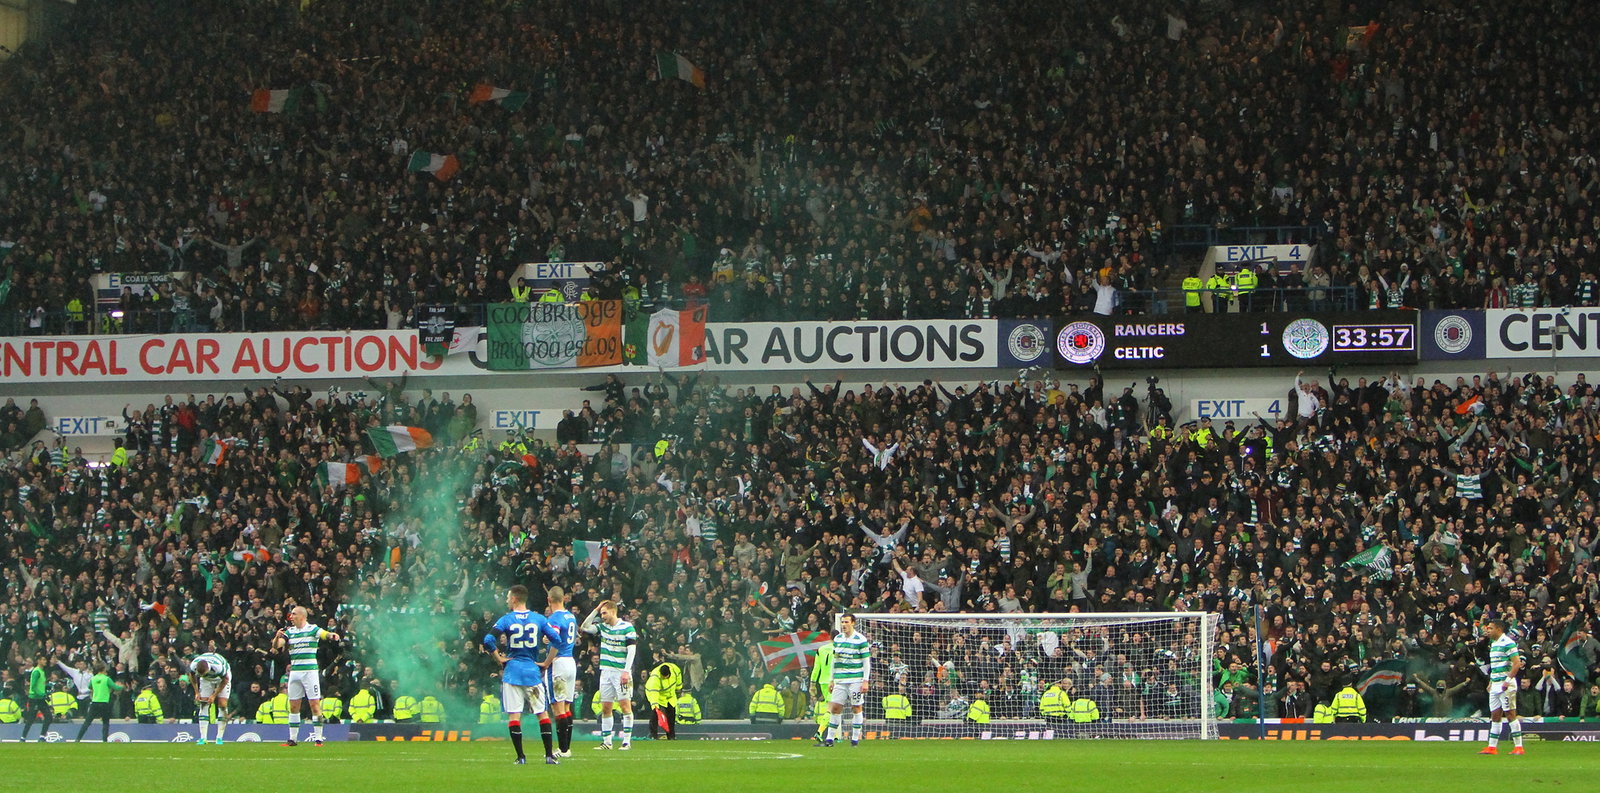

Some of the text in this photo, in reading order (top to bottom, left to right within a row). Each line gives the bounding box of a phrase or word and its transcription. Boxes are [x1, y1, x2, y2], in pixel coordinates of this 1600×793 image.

[1227, 246, 1301, 261] EXIT 4
[537, 263, 575, 278] EXIT
[1114, 322, 1269, 336] RANGERS 1
[1336, 328, 1410, 347] 33:57
[705, 326, 749, 365] AR
[761, 323, 985, 365] AUCTIONS
[1114, 344, 1270, 359] CELTIC 1
[0, 340, 127, 377] NTRAL
[139, 337, 220, 375] CAR
[1198, 400, 1281, 418] EXIT 4
[60, 417, 101, 434] EXIT
[496, 410, 541, 428] EXIT
[509, 622, 539, 649] 23
[566, 621, 576, 645] 9
[852, 691, 861, 700] 28
